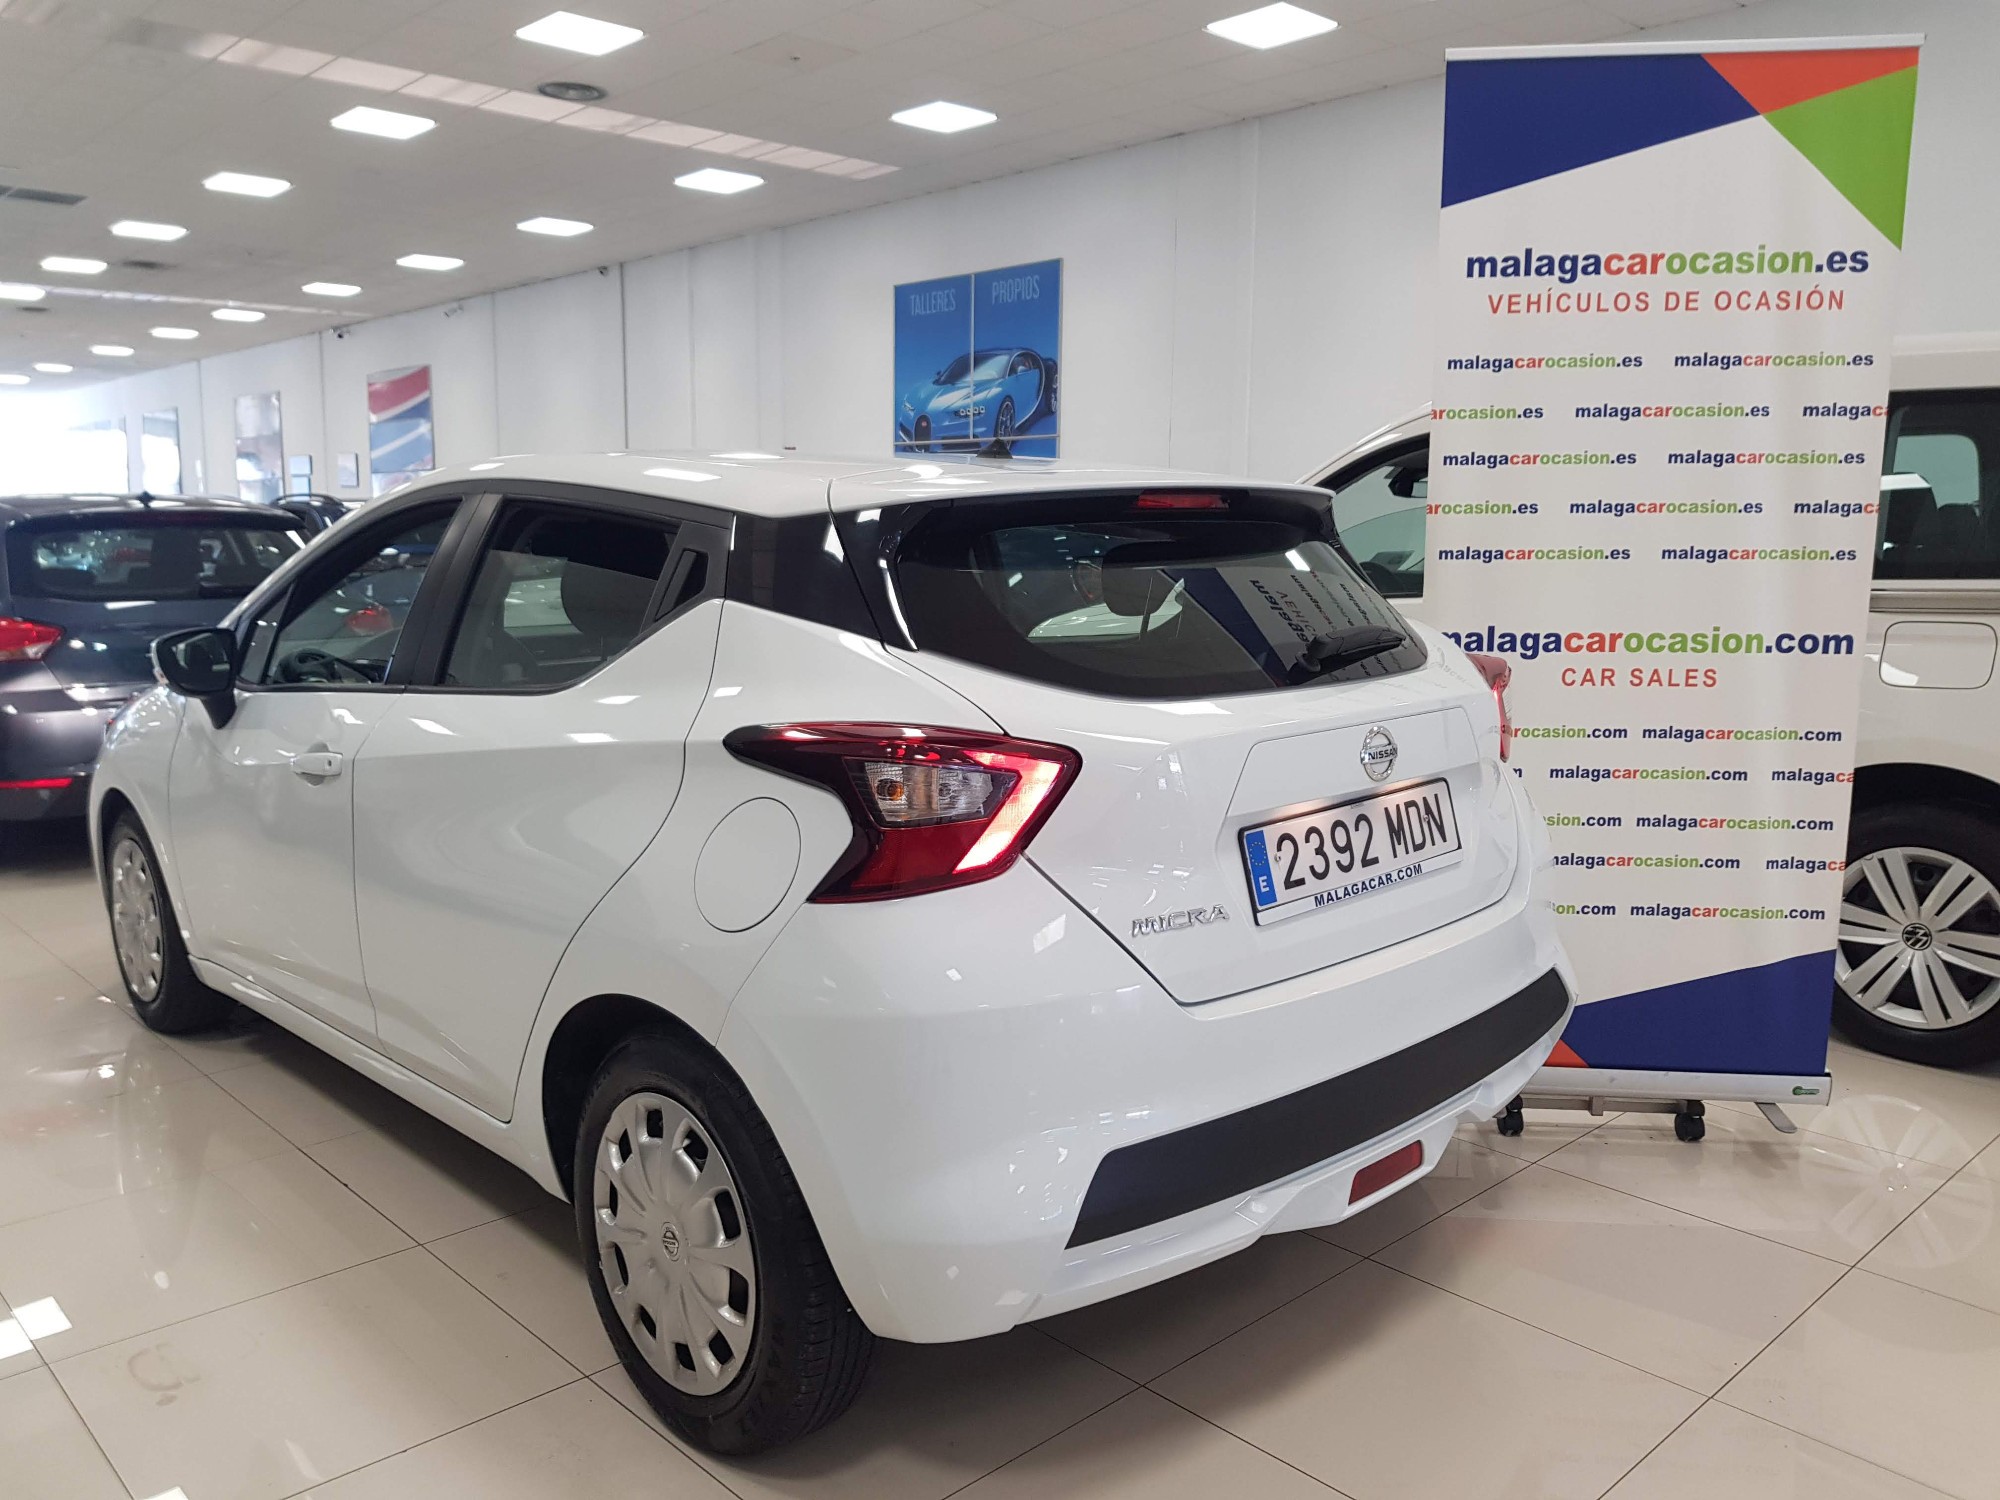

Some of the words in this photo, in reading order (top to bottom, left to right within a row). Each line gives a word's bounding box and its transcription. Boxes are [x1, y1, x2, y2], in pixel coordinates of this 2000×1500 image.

[1467, 244, 1868, 283] malagacarocasion.es
[910, 289, 956, 316] TALLERES
[992, 274, 1040, 305] PROPIOS
[1488, 288, 1649, 314] VEHÍCULOS
[1665, 291, 1699, 311] DE
[1714, 285, 1843, 311] OCASIÓN
[1448, 353, 1642, 373] malagacarocasion.es
[1675, 352, 1873, 370] malagacarocasion.es
[1576, 403, 1769, 421] malagacarocasion.es
[1803, 402, 1887, 420] malagac
[1443, 451, 1636, 469] malagacarocasion.es
[1668, 450, 1865, 467] malagacarocasion.es
[1570, 499, 1762, 517] malagacarocasion.es
[1439, 546, 1630, 563] malagacarocasion.es
[1662, 546, 1856, 563] malagacarocasion.es
[1562, 668, 1615, 686] CAR
[1630, 668, 1716, 687] SALES
[1510, 723, 1627, 738] rocasion.com
[1643, 726, 1841, 742] malagacarocasion.com
[1550, 765, 1747, 782] malagacarocasion.com
[1544, 813, 1621, 826] sion.com
[1636, 814, 1833, 831] malagacarocasion.com
[1276, 813, 1380, 890] 2392
[1384, 793, 1447, 859] MDN
[1258, 875, 1270, 893] E
[1314, 863, 1423, 908] MALAGACAR.COM
[1131, 903, 1230, 938] MICRA
[1630, 903, 1825, 920] malagacarocasion.com
